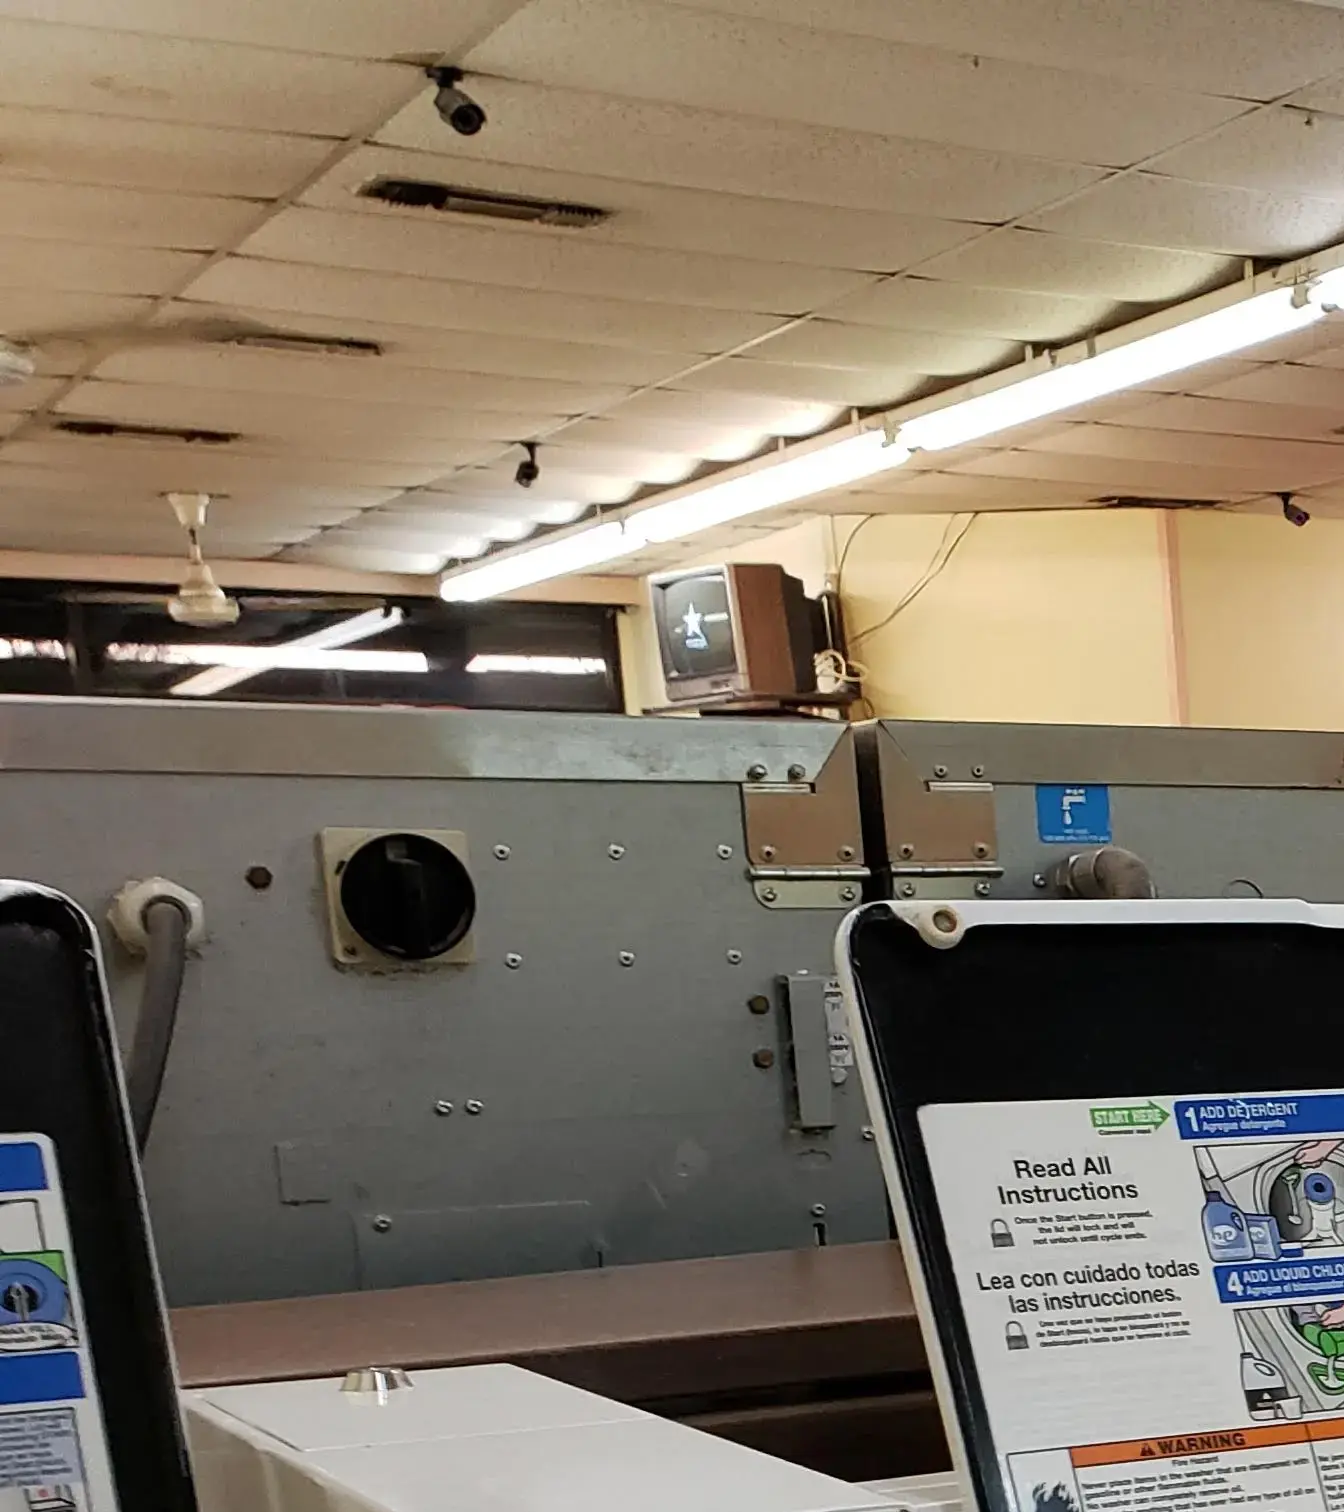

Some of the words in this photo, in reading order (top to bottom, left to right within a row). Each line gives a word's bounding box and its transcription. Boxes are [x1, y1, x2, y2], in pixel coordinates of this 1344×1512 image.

[1185, 1107, 1198, 1132] 1
[1200, 1104, 1224, 1119] ADD
[1227, 1102, 1298, 1118] DETERGENT
[1013, 1158, 1076, 1179] Read
[1084, 1156, 1112, 1175] All
[998, 1182, 1138, 1204] Instructions
[976, 1273, 1015, 1291] Lea
[1021, 1273, 1058, 1288] con
[1064, 1263, 1140, 1285] cuidado
[1145, 1260, 1200, 1279] todas
[1227, 1272, 1242, 1296] 4
[1243, 1269, 1268, 1283] ADD
[1271, 1266, 1310, 1281] LIQUID
[1008, 1295, 1039, 1313] las
[1044, 1287, 1181, 1311] instrucciones.
[1157, 1433, 1246, 1454] WARNING
